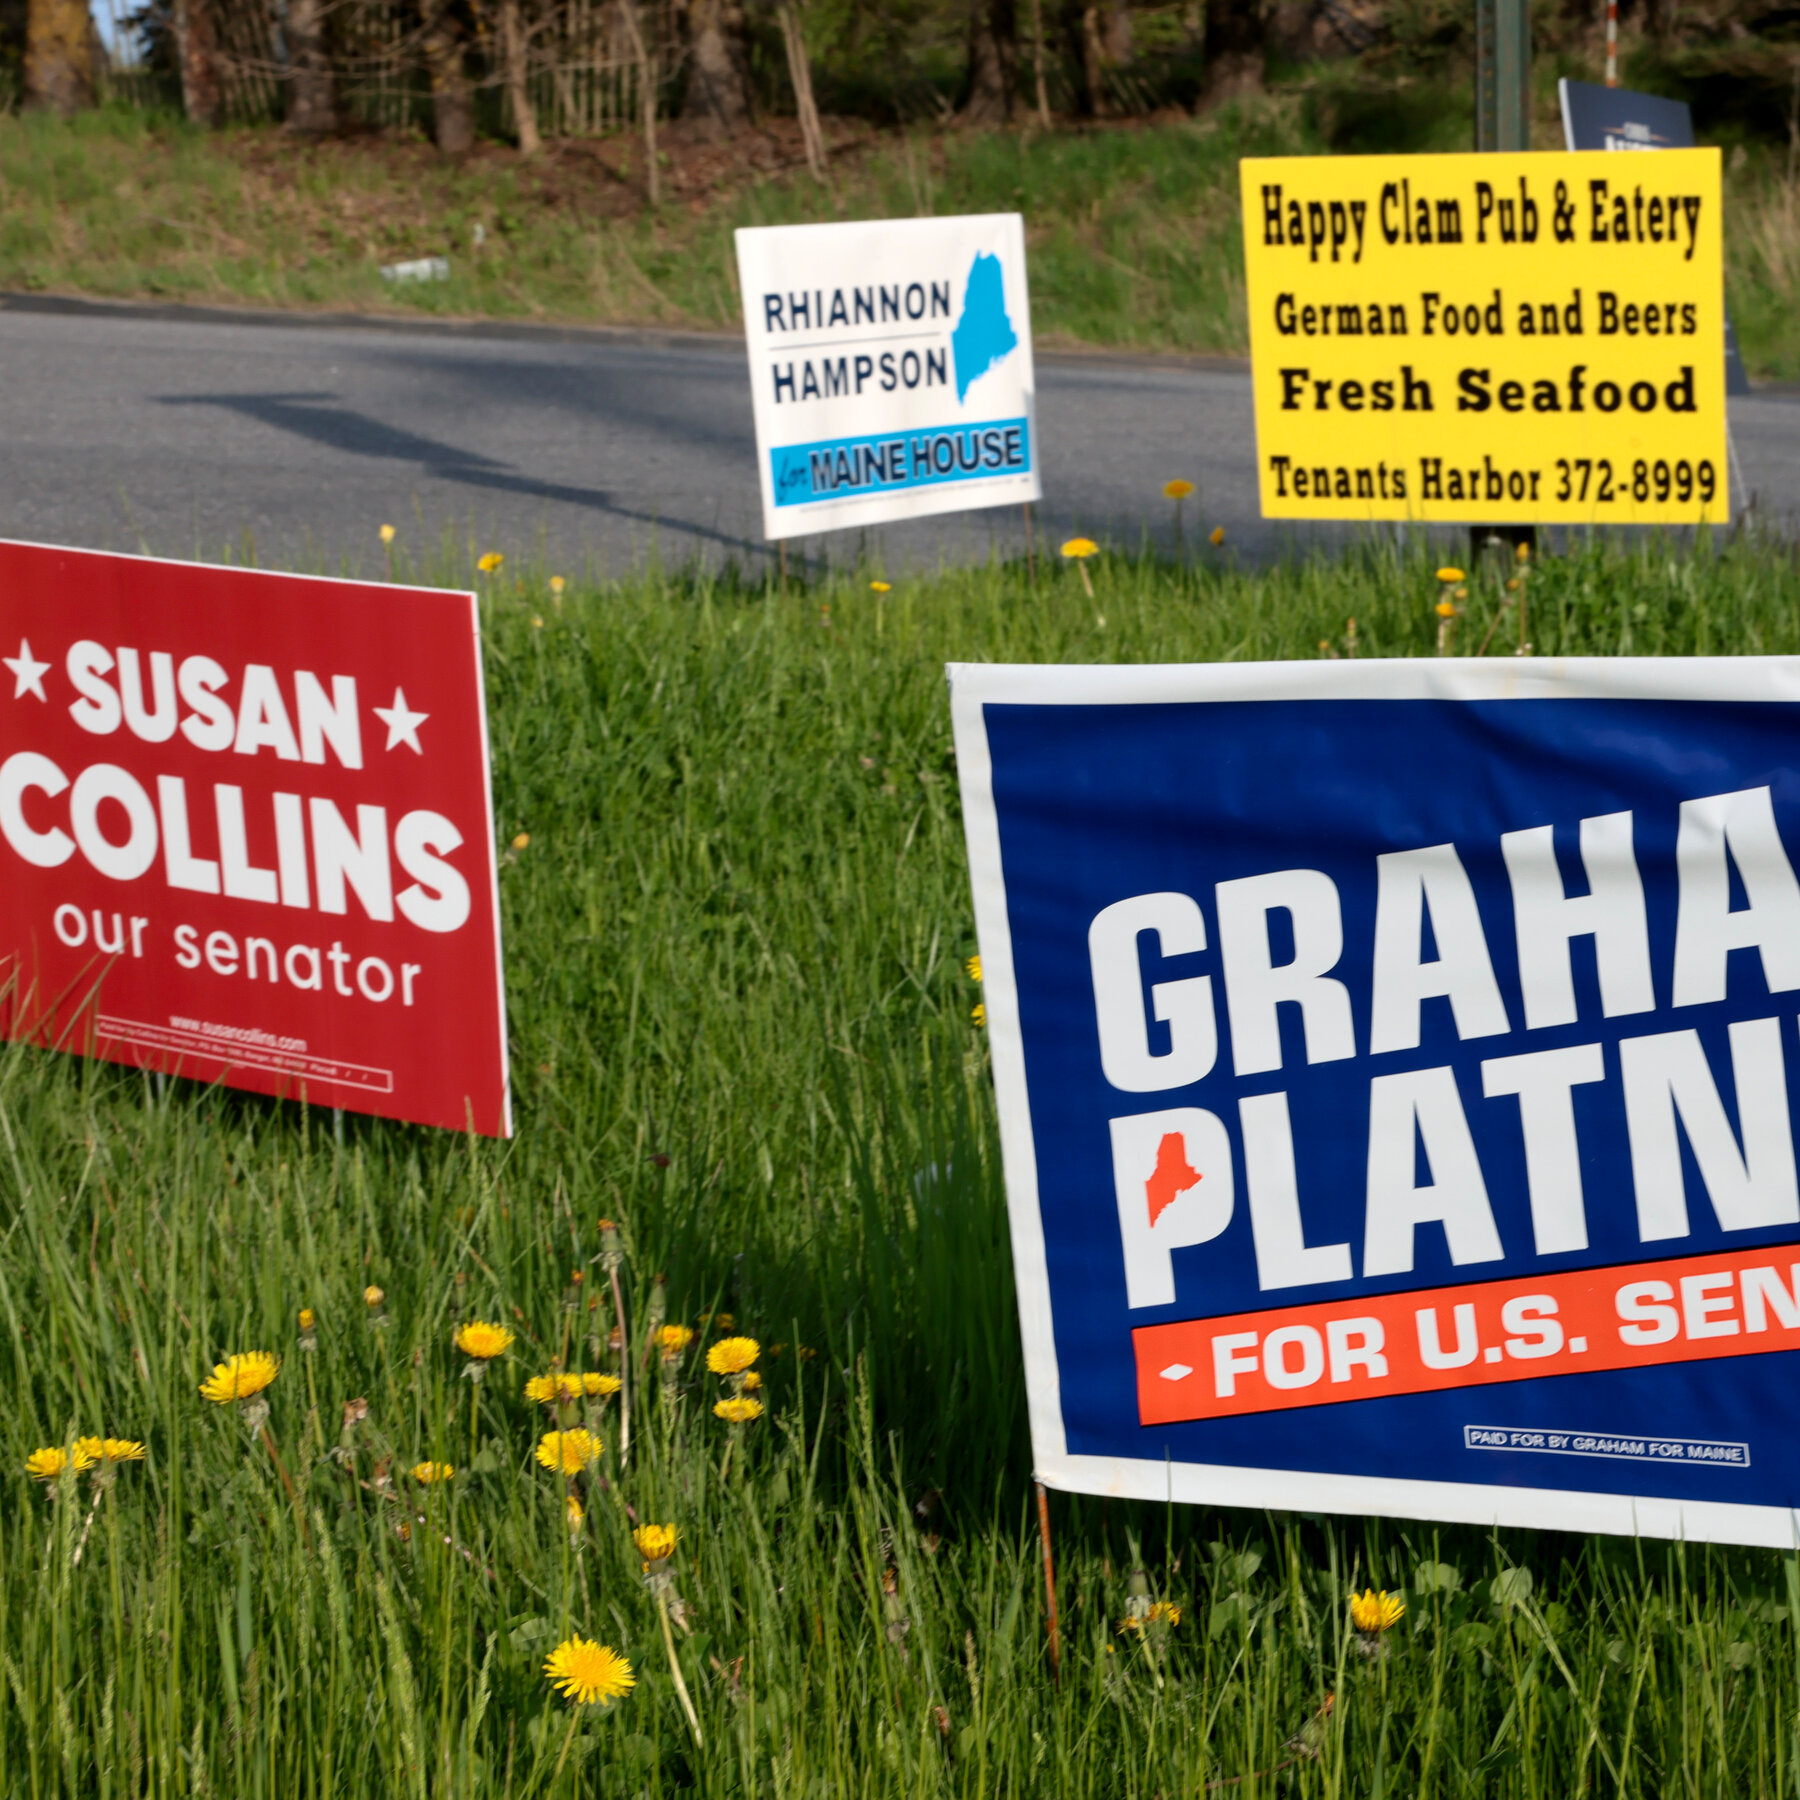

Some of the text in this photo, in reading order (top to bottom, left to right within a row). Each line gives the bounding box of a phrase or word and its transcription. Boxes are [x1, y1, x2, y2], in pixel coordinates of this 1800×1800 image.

[1262, 177, 1700, 262] Happy Clam Pub & Eatery
[763, 280, 950, 332] RHIANNON
[1275, 289, 1695, 335] German Food and Beers
[772, 347, 948, 404] HAMPSON
[1280, 366, 1696, 412] Fresh Seafood
[777, 456, 807, 502] for
[808, 440, 906, 493] MAINE
[910, 426, 1023, 479] HOUSE
[1271, 456, 1715, 502] Tenants Harbor 372-8999
[67, 640, 363, 769] SUSAN
[0, 752, 470, 932] COLLINS
[54, 904, 420, 1005] our senator
[1089, 786, 1800, 1092] GRAHA
[169, 1015, 307, 1052] www.susancollins.com
[1109, 1015, 1800, 1309] PLATN
[1212, 1263, 1800, 1397] FOR U.S. SEN
[1470, 1430, 1744, 1462] PAID FOR BY GRAHAM FOR MAINE
